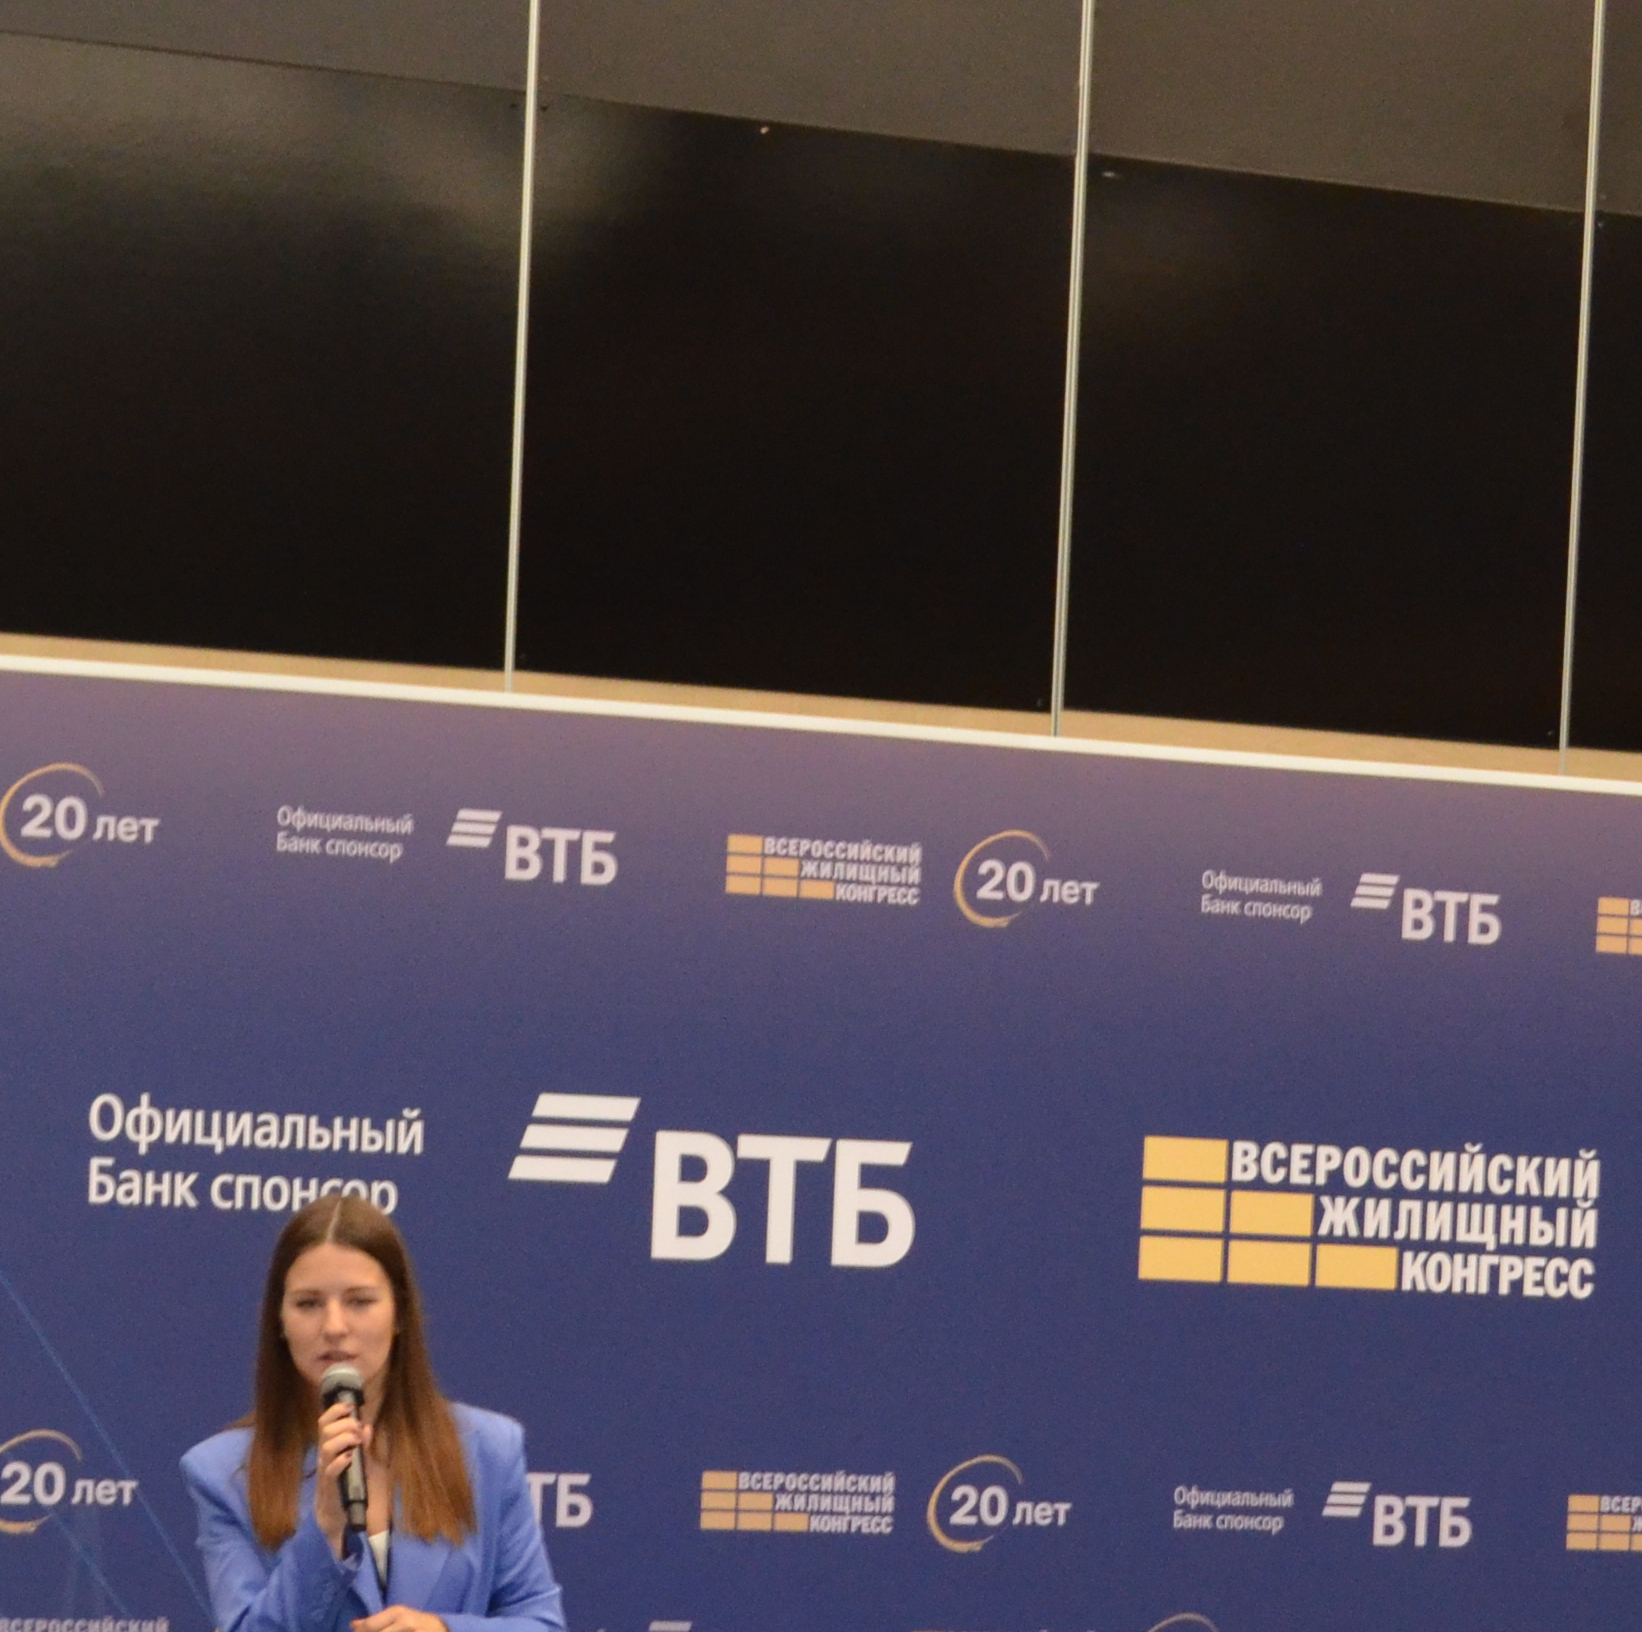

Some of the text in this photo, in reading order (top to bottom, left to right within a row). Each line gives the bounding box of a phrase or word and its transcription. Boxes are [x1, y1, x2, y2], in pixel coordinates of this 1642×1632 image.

[21, 793, 160, 846] 20 лет
[275, 804, 414, 839] Официальный
[275, 829, 403, 863] Банк спонсор
[504, 823, 618, 886] ВТБ
[764, 836, 922, 863] ВСЕРОССИЙСКИЙ
[800, 859, 921, 884] ЖИЛИЩНЫЙ
[977, 859, 1100, 907] 20 лет
[1200, 869, 1323, 899] Официальный
[835, 882, 920, 906] КОНГРЕСС
[1200, 892, 1313, 924] Банк спонсор
[1400, 888, 1502, 946] ВТБ
[87, 1092, 425, 1155] Официальный
[86, 1156, 199, 1209] Банк
[1229, 1140, 1601, 1201] ВСЕРОССИЙСКИЙ
[650, 1129, 917, 1268] ВТБ
[1317, 1194, 1599, 1251] ЖИЛИЩНЫЙ
[1400, 1248, 1596, 1301] КОНГРЕСС
[0, 1461, 139, 1507] 20 лет
[525, 1471, 594, 1528] ТБ
[737, 1471, 896, 1495] ВСЕРОССИЙСКИЙ
[773, 1490, 896, 1514] ЖИЛИЩНЫЙ
[1172, 1485, 1294, 1511] Официальный
[808, 1513, 894, 1535] КОНГРЕСС
[949, 1484, 1073, 1527] 20 лет
[1172, 1508, 1285, 1535] Банк спонсор
[1371, 1494, 1473, 1549] ВТБ
